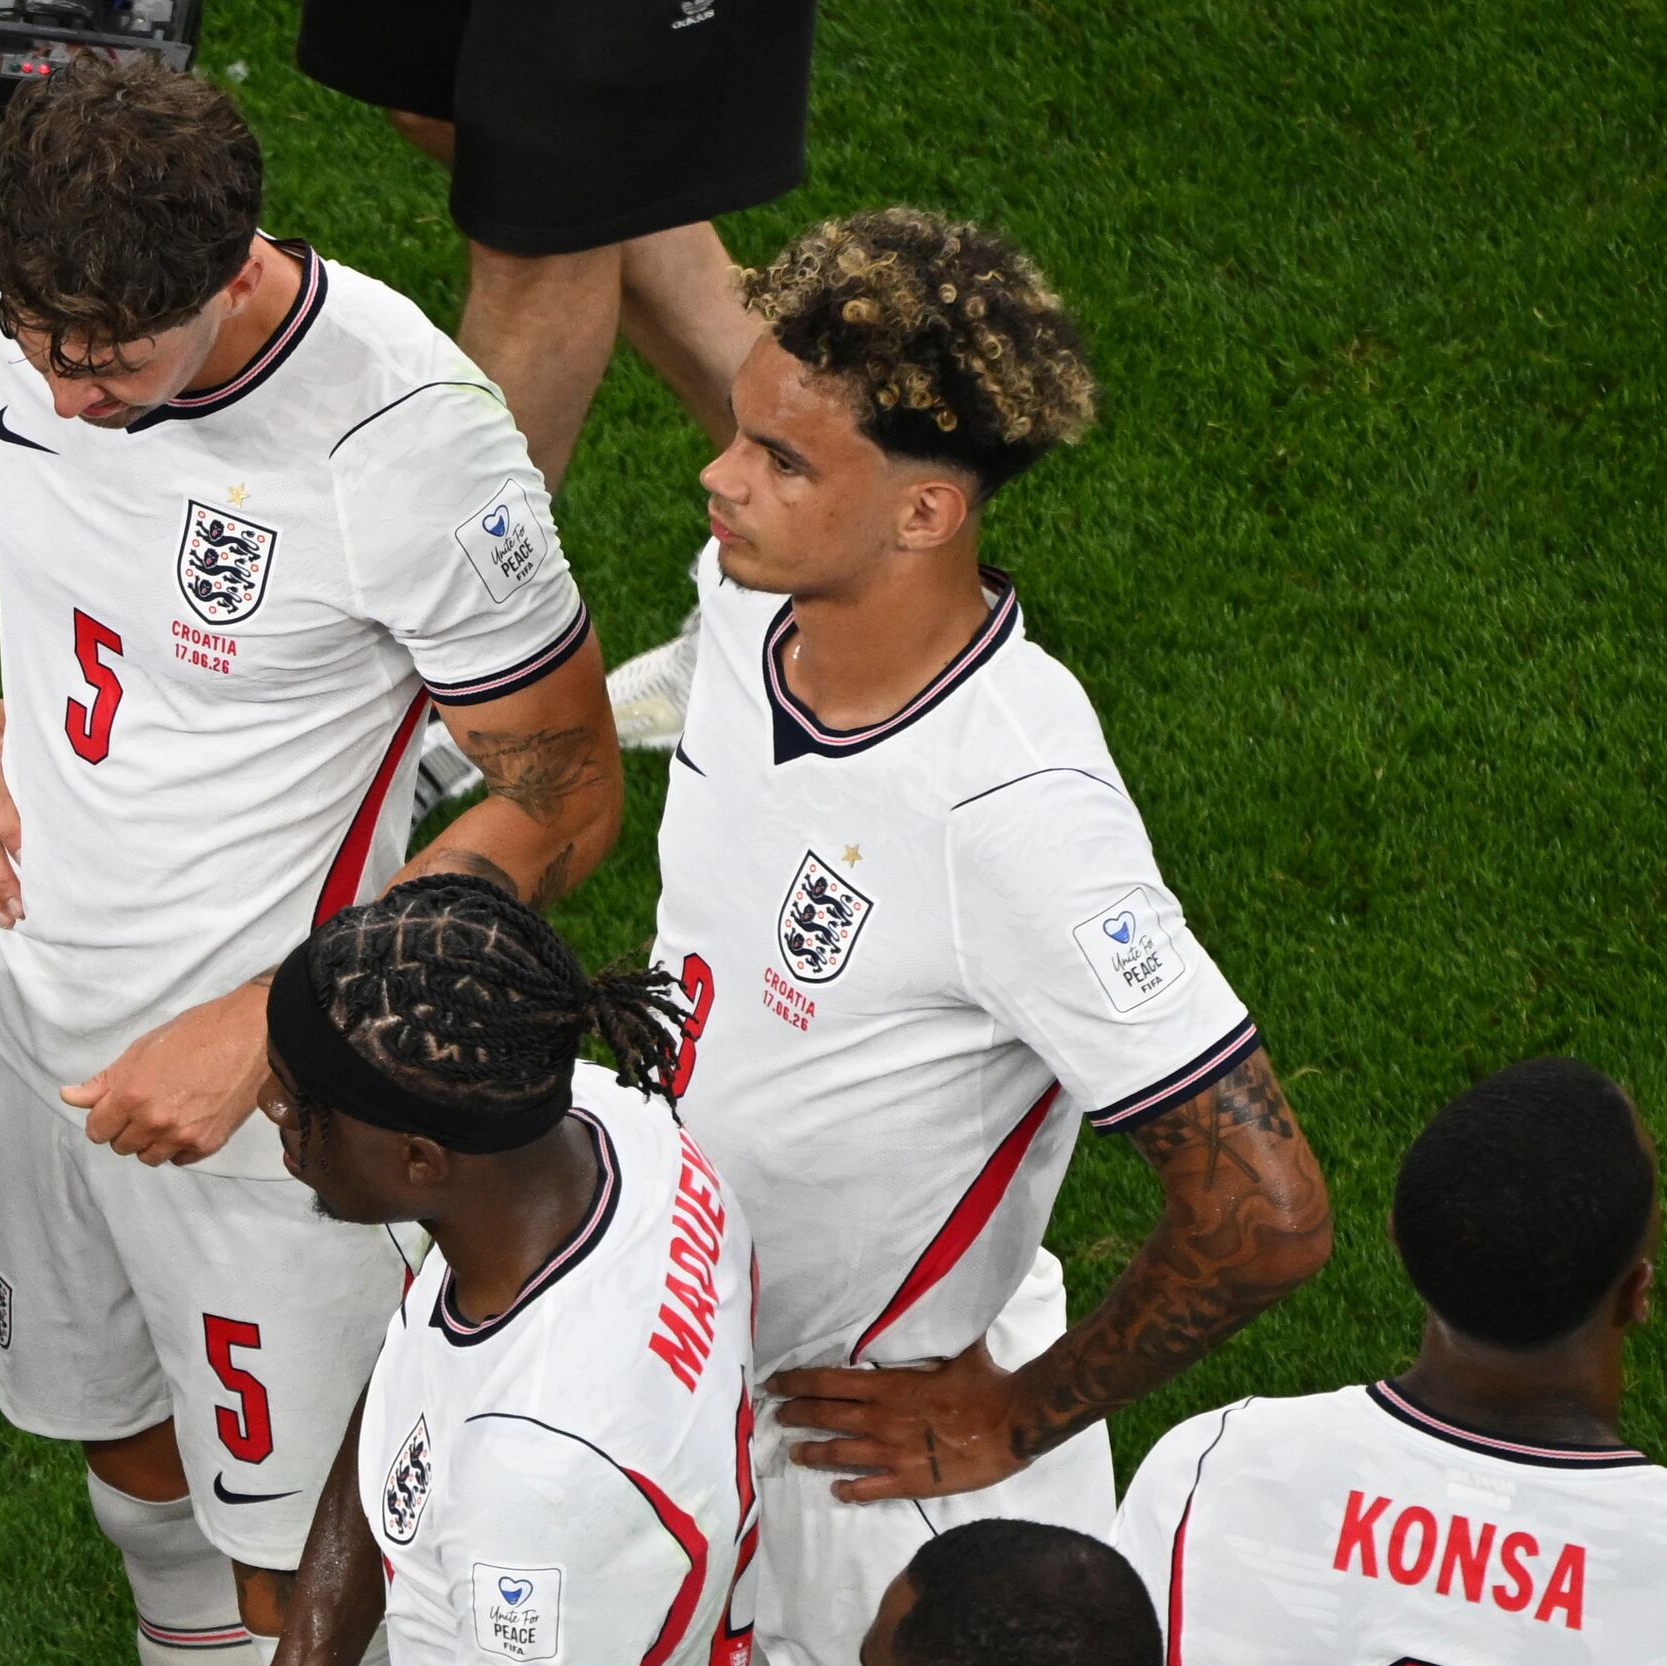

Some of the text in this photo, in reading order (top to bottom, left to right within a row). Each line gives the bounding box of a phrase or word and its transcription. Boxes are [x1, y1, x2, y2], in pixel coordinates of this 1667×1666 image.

[500, 537, 534, 578] PEACE
[516, 562, 534, 581] FIFA
[171, 619, 237, 657] CROATIA
[174, 642, 230, 675] 17.06.26
[64, 606, 124, 766] 5
[1122, 951, 1164, 988] PEACE
[1140, 975, 1164, 994] FIFA
[762, 989, 809, 1032] 17.06.26
[764, 967, 815, 1018] CROATIA
[648, 1127, 727, 1394] MADUEK
[203, 1312, 274, 1466] 5
[1332, 1488, 1588, 1632] KONSA
[490, 1606, 520, 1623] Unite
[494, 1622, 537, 1645] PEACE
[503, 1642, 526, 1656] FIFA
